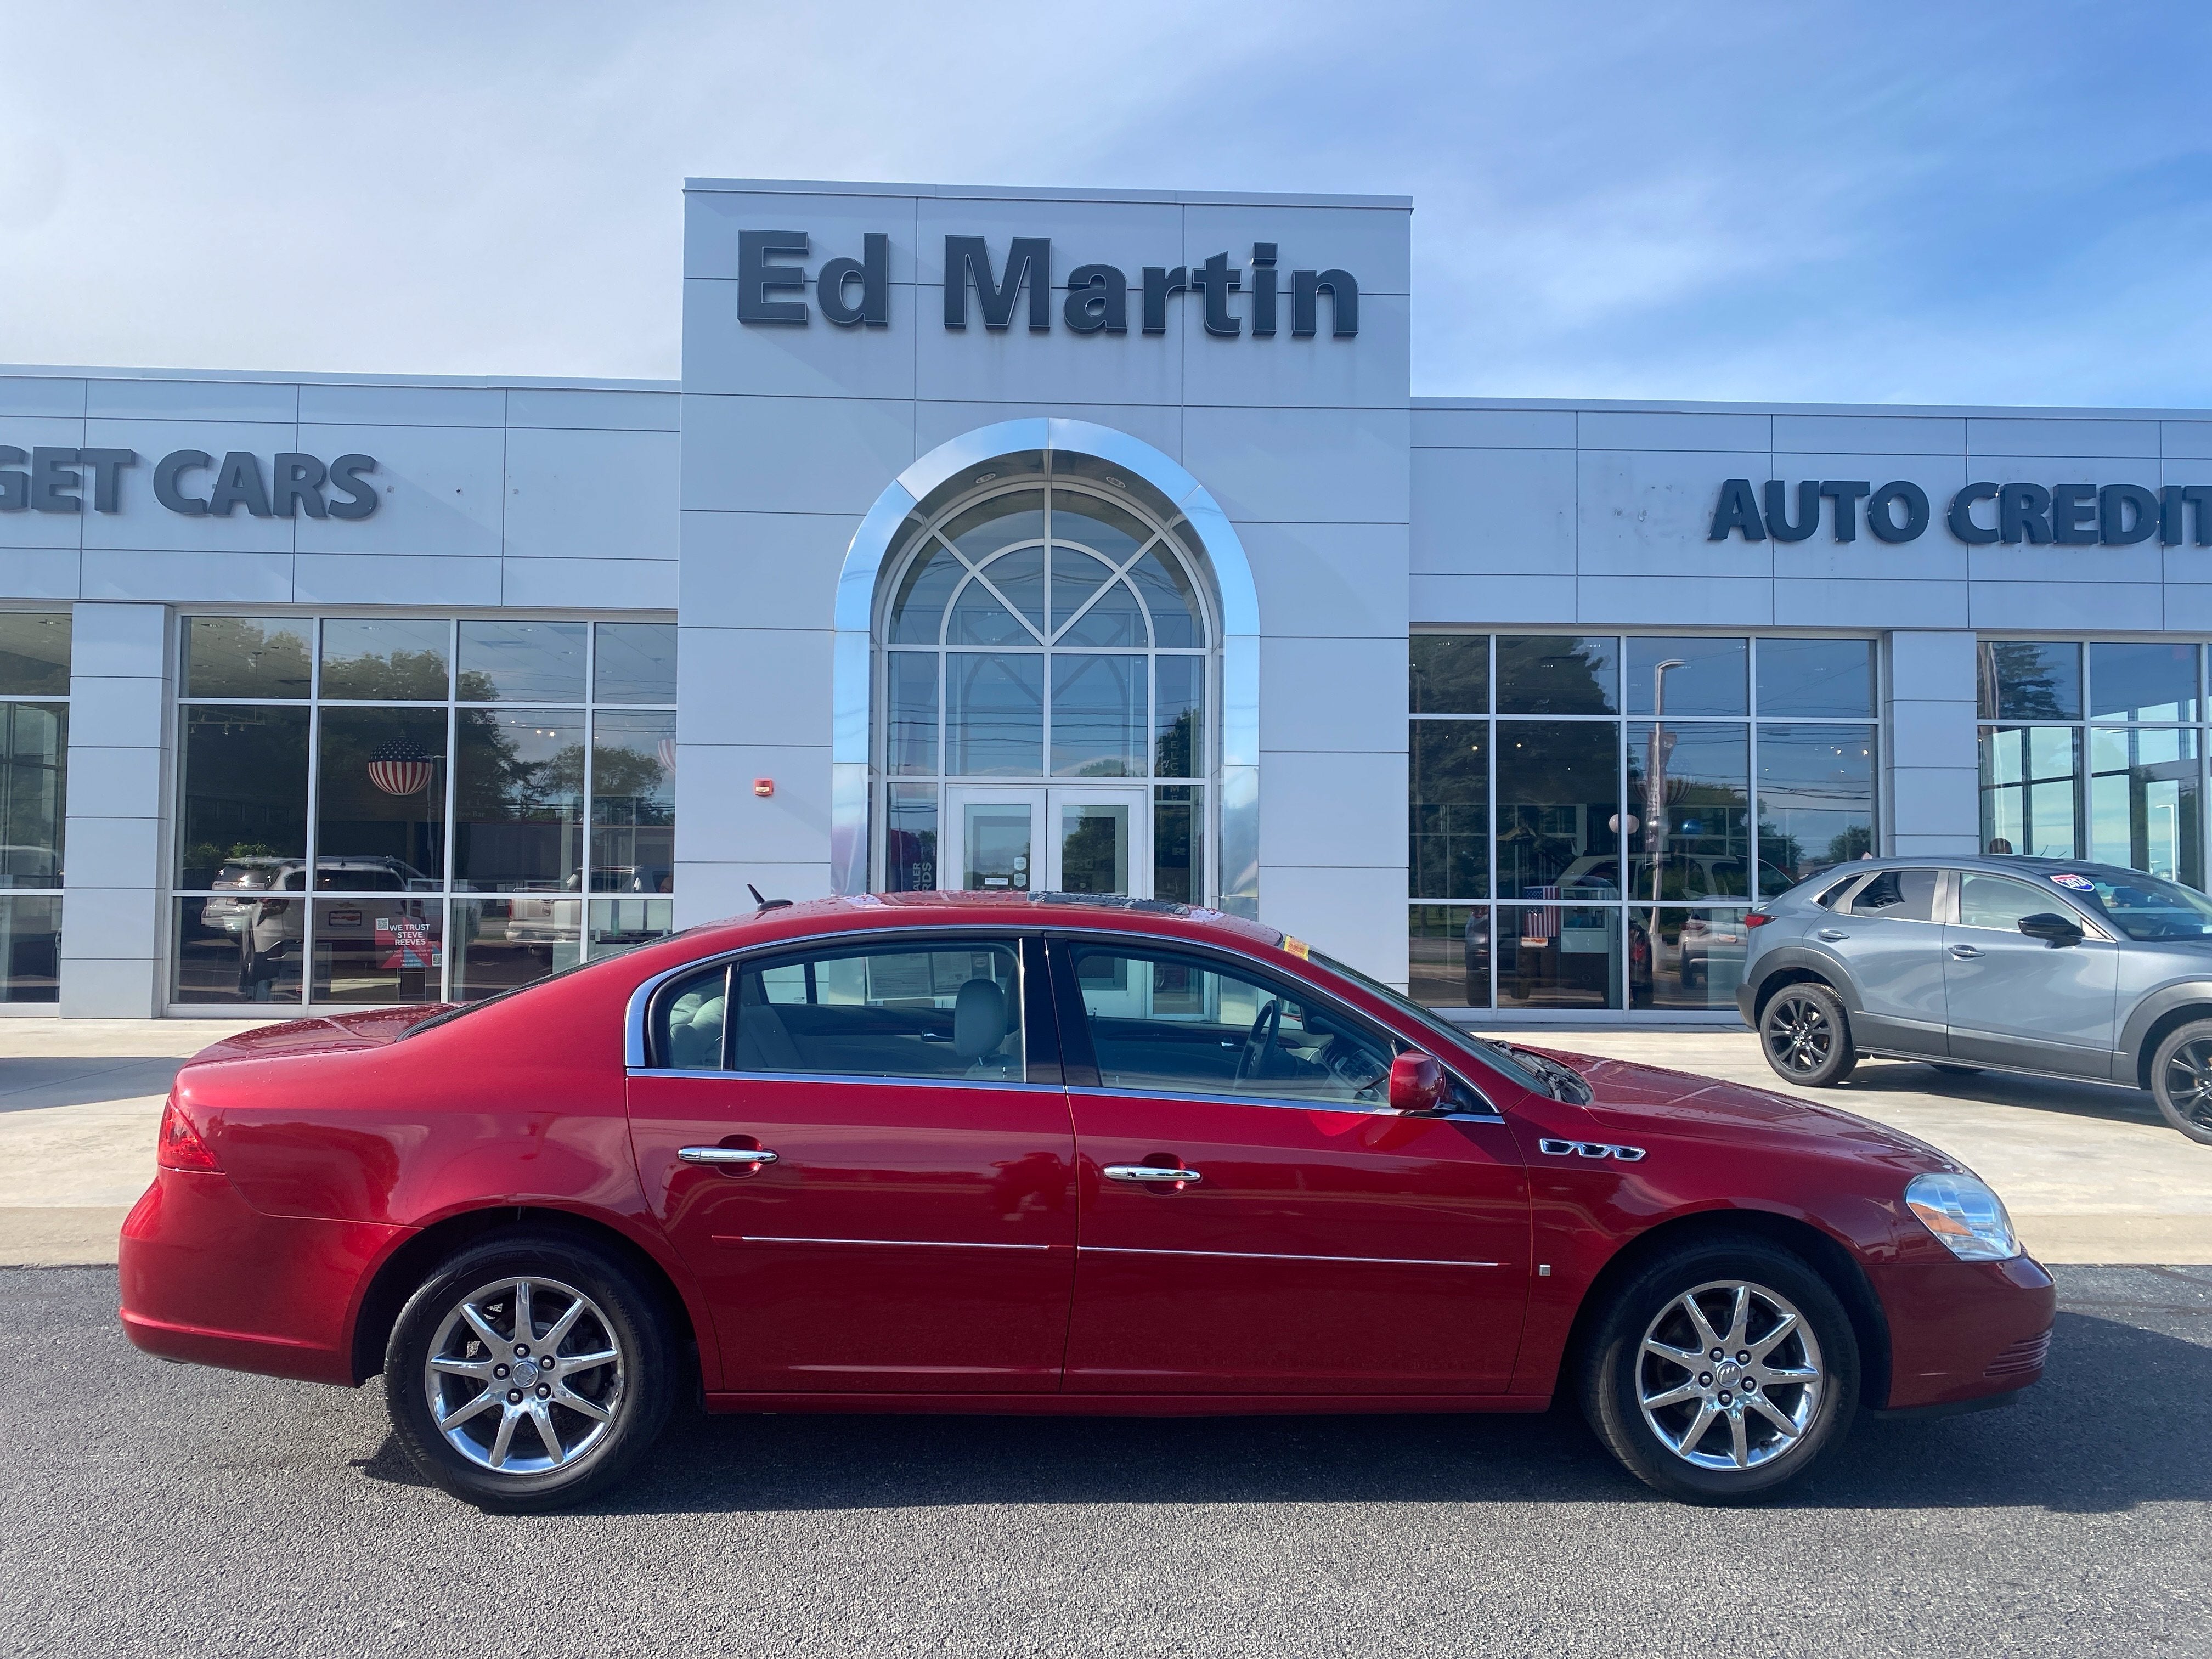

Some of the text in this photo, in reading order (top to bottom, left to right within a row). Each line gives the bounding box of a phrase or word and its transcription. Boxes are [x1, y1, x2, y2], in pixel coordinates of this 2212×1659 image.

[738, 229, 1359, 337] Ed Martin
[153, 449, 378, 519] CARS
[1707, 478, 2212, 547] AUTO CREDIT
